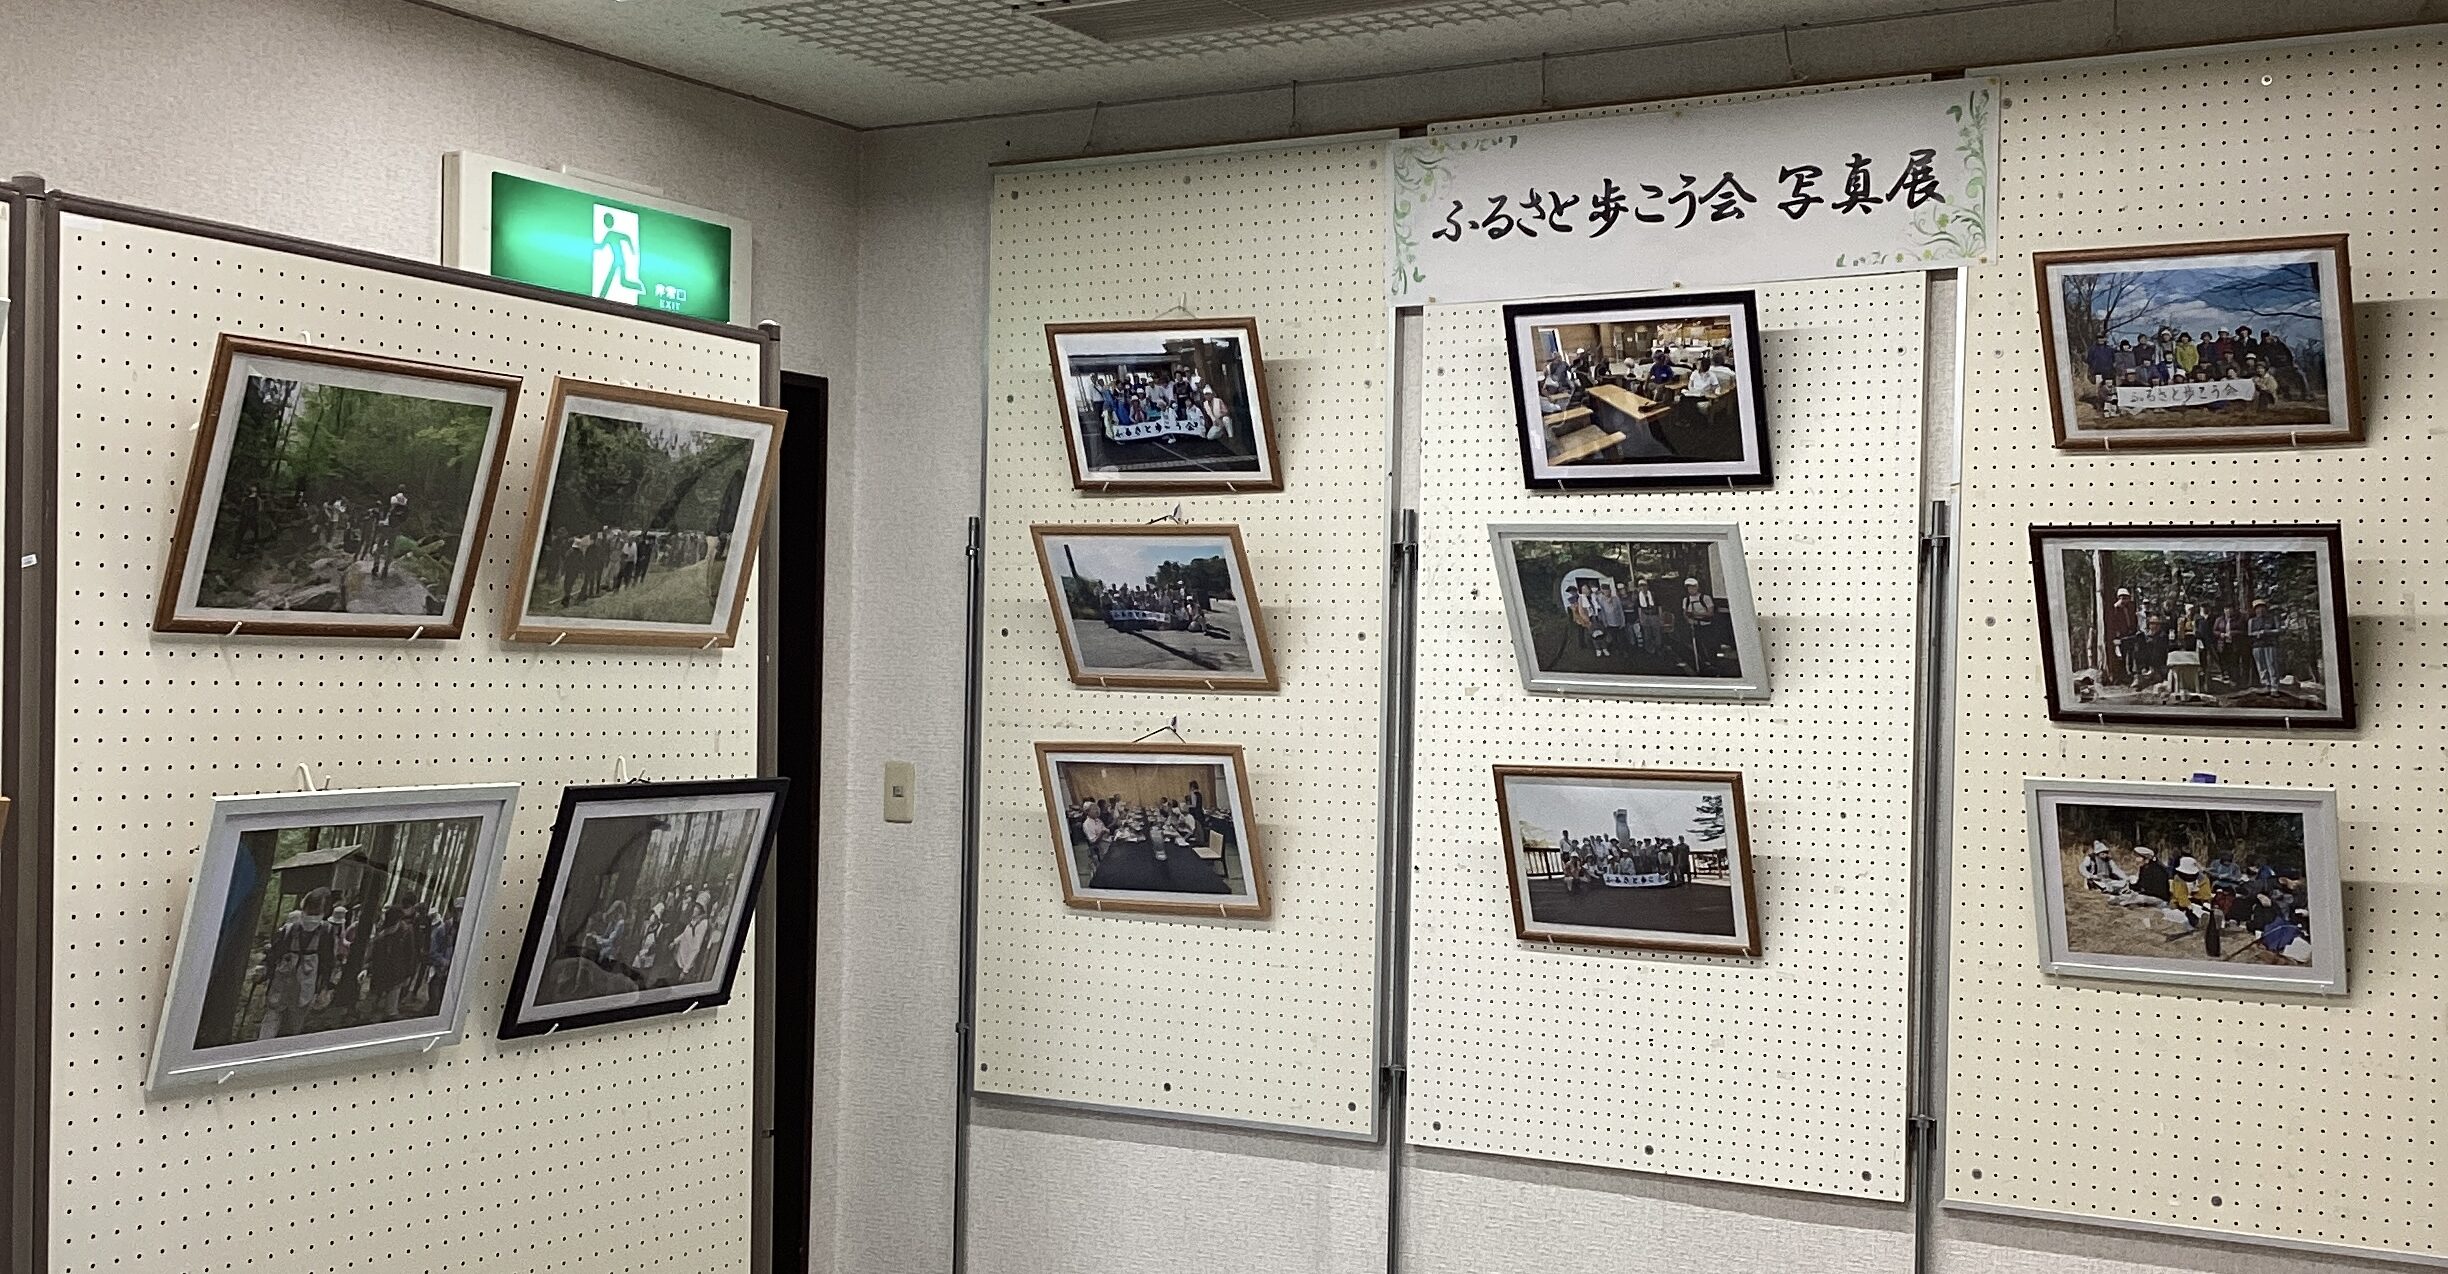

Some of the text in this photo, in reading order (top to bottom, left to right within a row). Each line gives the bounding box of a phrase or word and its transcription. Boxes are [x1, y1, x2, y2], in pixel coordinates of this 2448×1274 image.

[1431, 148, 1947, 243] ふるさと歩こう会 写真展
[660, 299, 681, 311] EXIT
